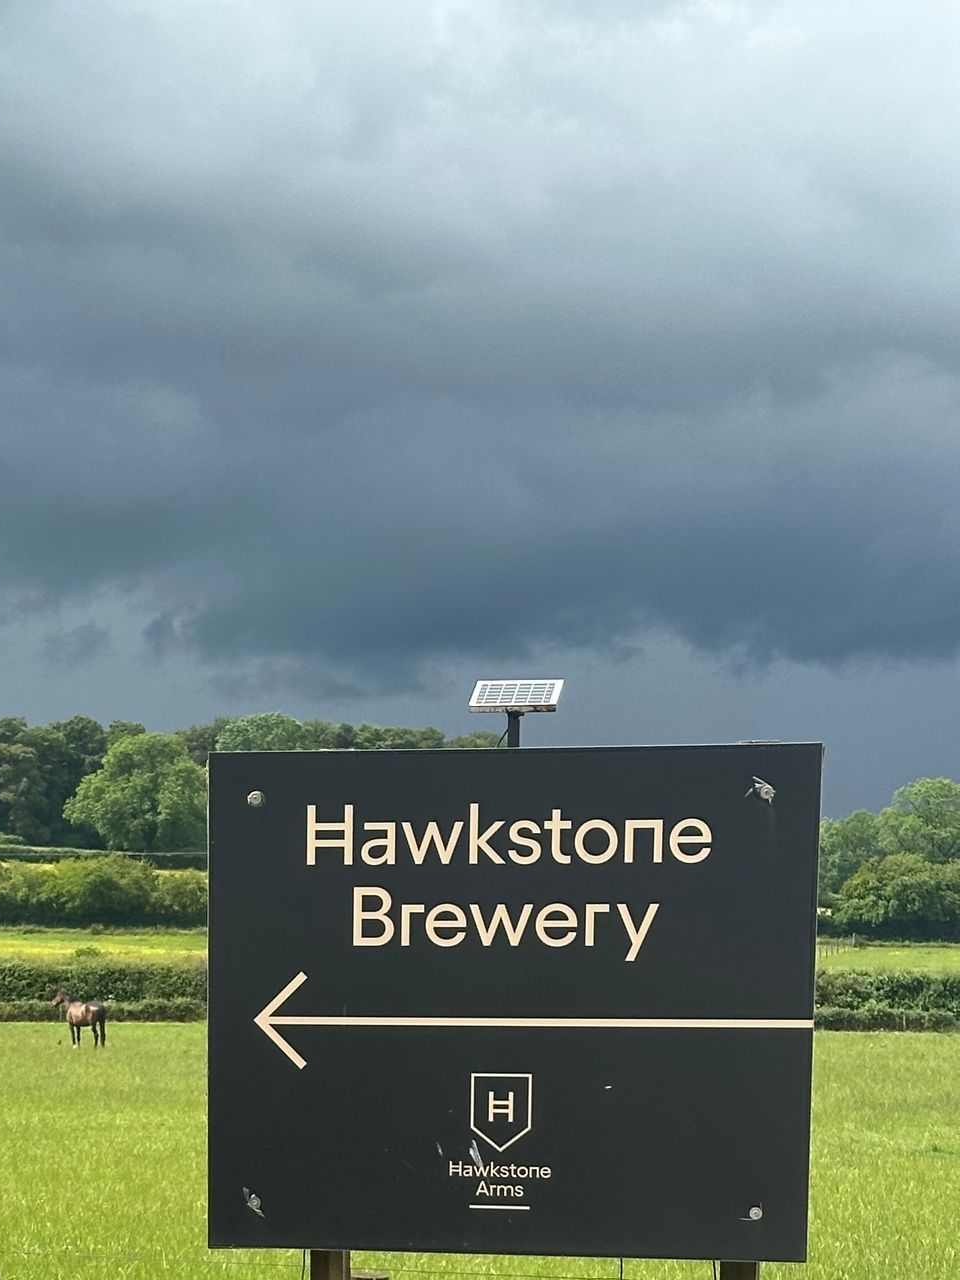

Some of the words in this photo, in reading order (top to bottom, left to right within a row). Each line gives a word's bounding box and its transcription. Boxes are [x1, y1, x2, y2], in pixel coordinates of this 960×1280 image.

[307, 803, 712, 865] Hawkstone
[353, 887, 659, 961] Brewery
[489, 1091, 513, 1122] H
[448, 1160, 552, 1179] Hawkstone
[475, 1180, 524, 1198] Arms
